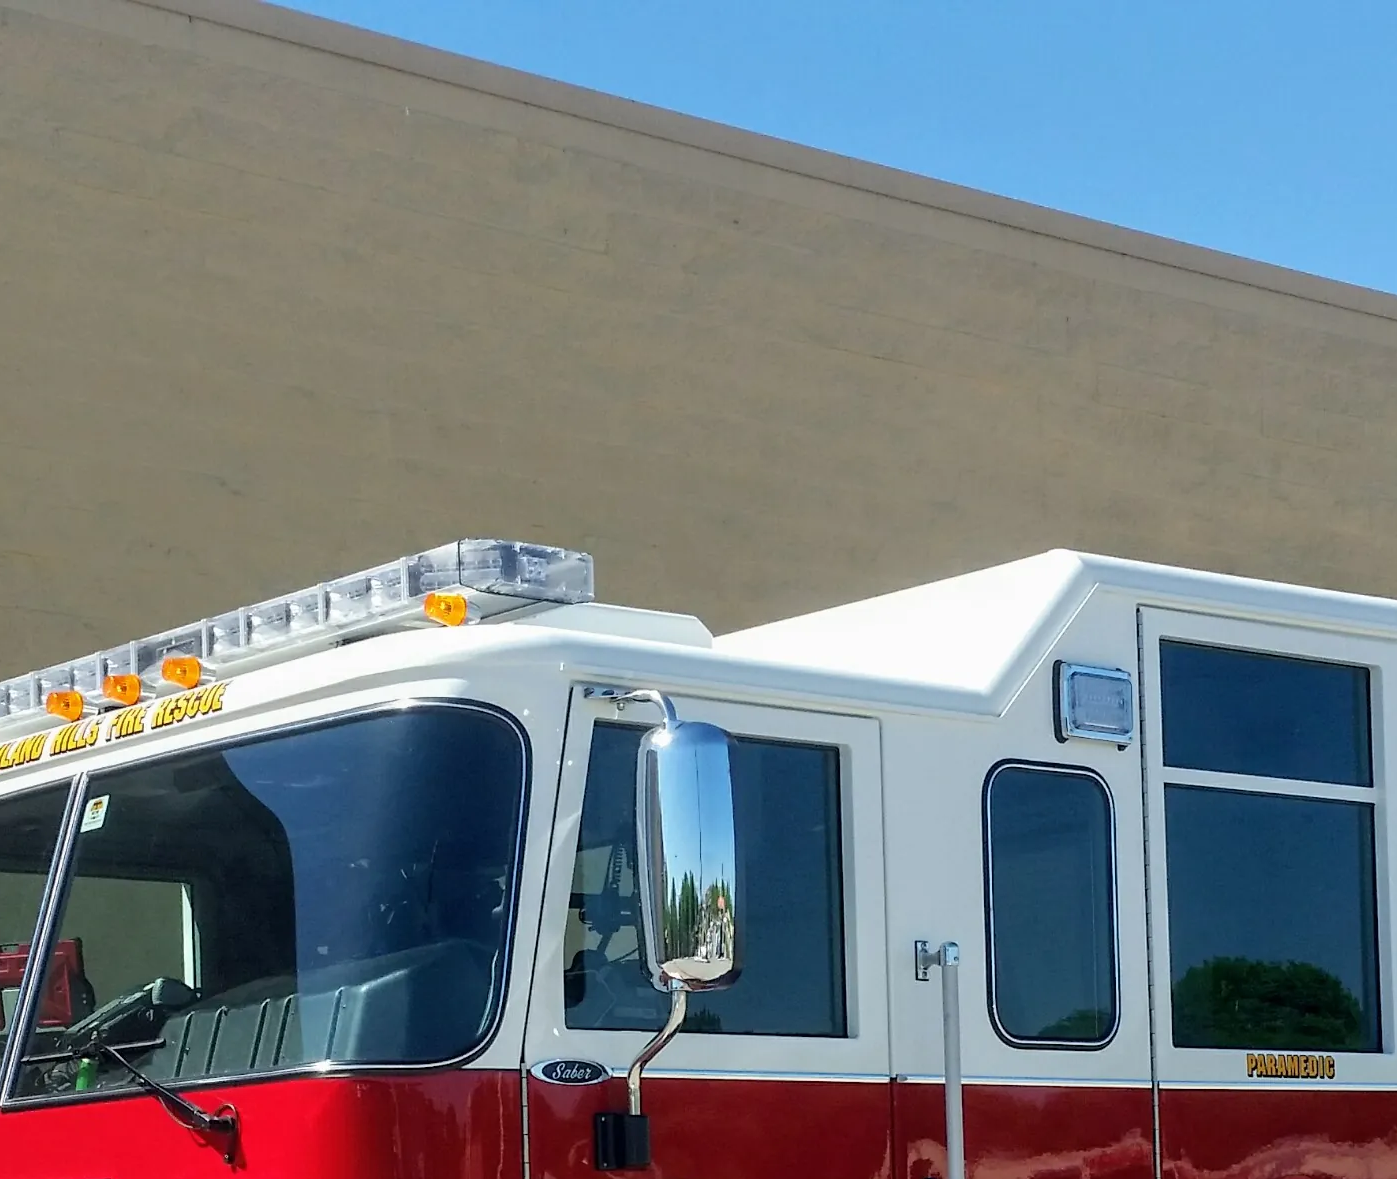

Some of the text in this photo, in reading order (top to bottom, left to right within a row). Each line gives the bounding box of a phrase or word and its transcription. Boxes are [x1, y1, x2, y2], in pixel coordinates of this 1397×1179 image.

[49, 717, 100, 756] HILLS
[105, 706, 147, 741] FIRE
[151, 682, 227, 730] RESCUE
[552, 1062, 592, 1079] Saber
[1246, 1053, 1335, 1079] PARAMEDIC
